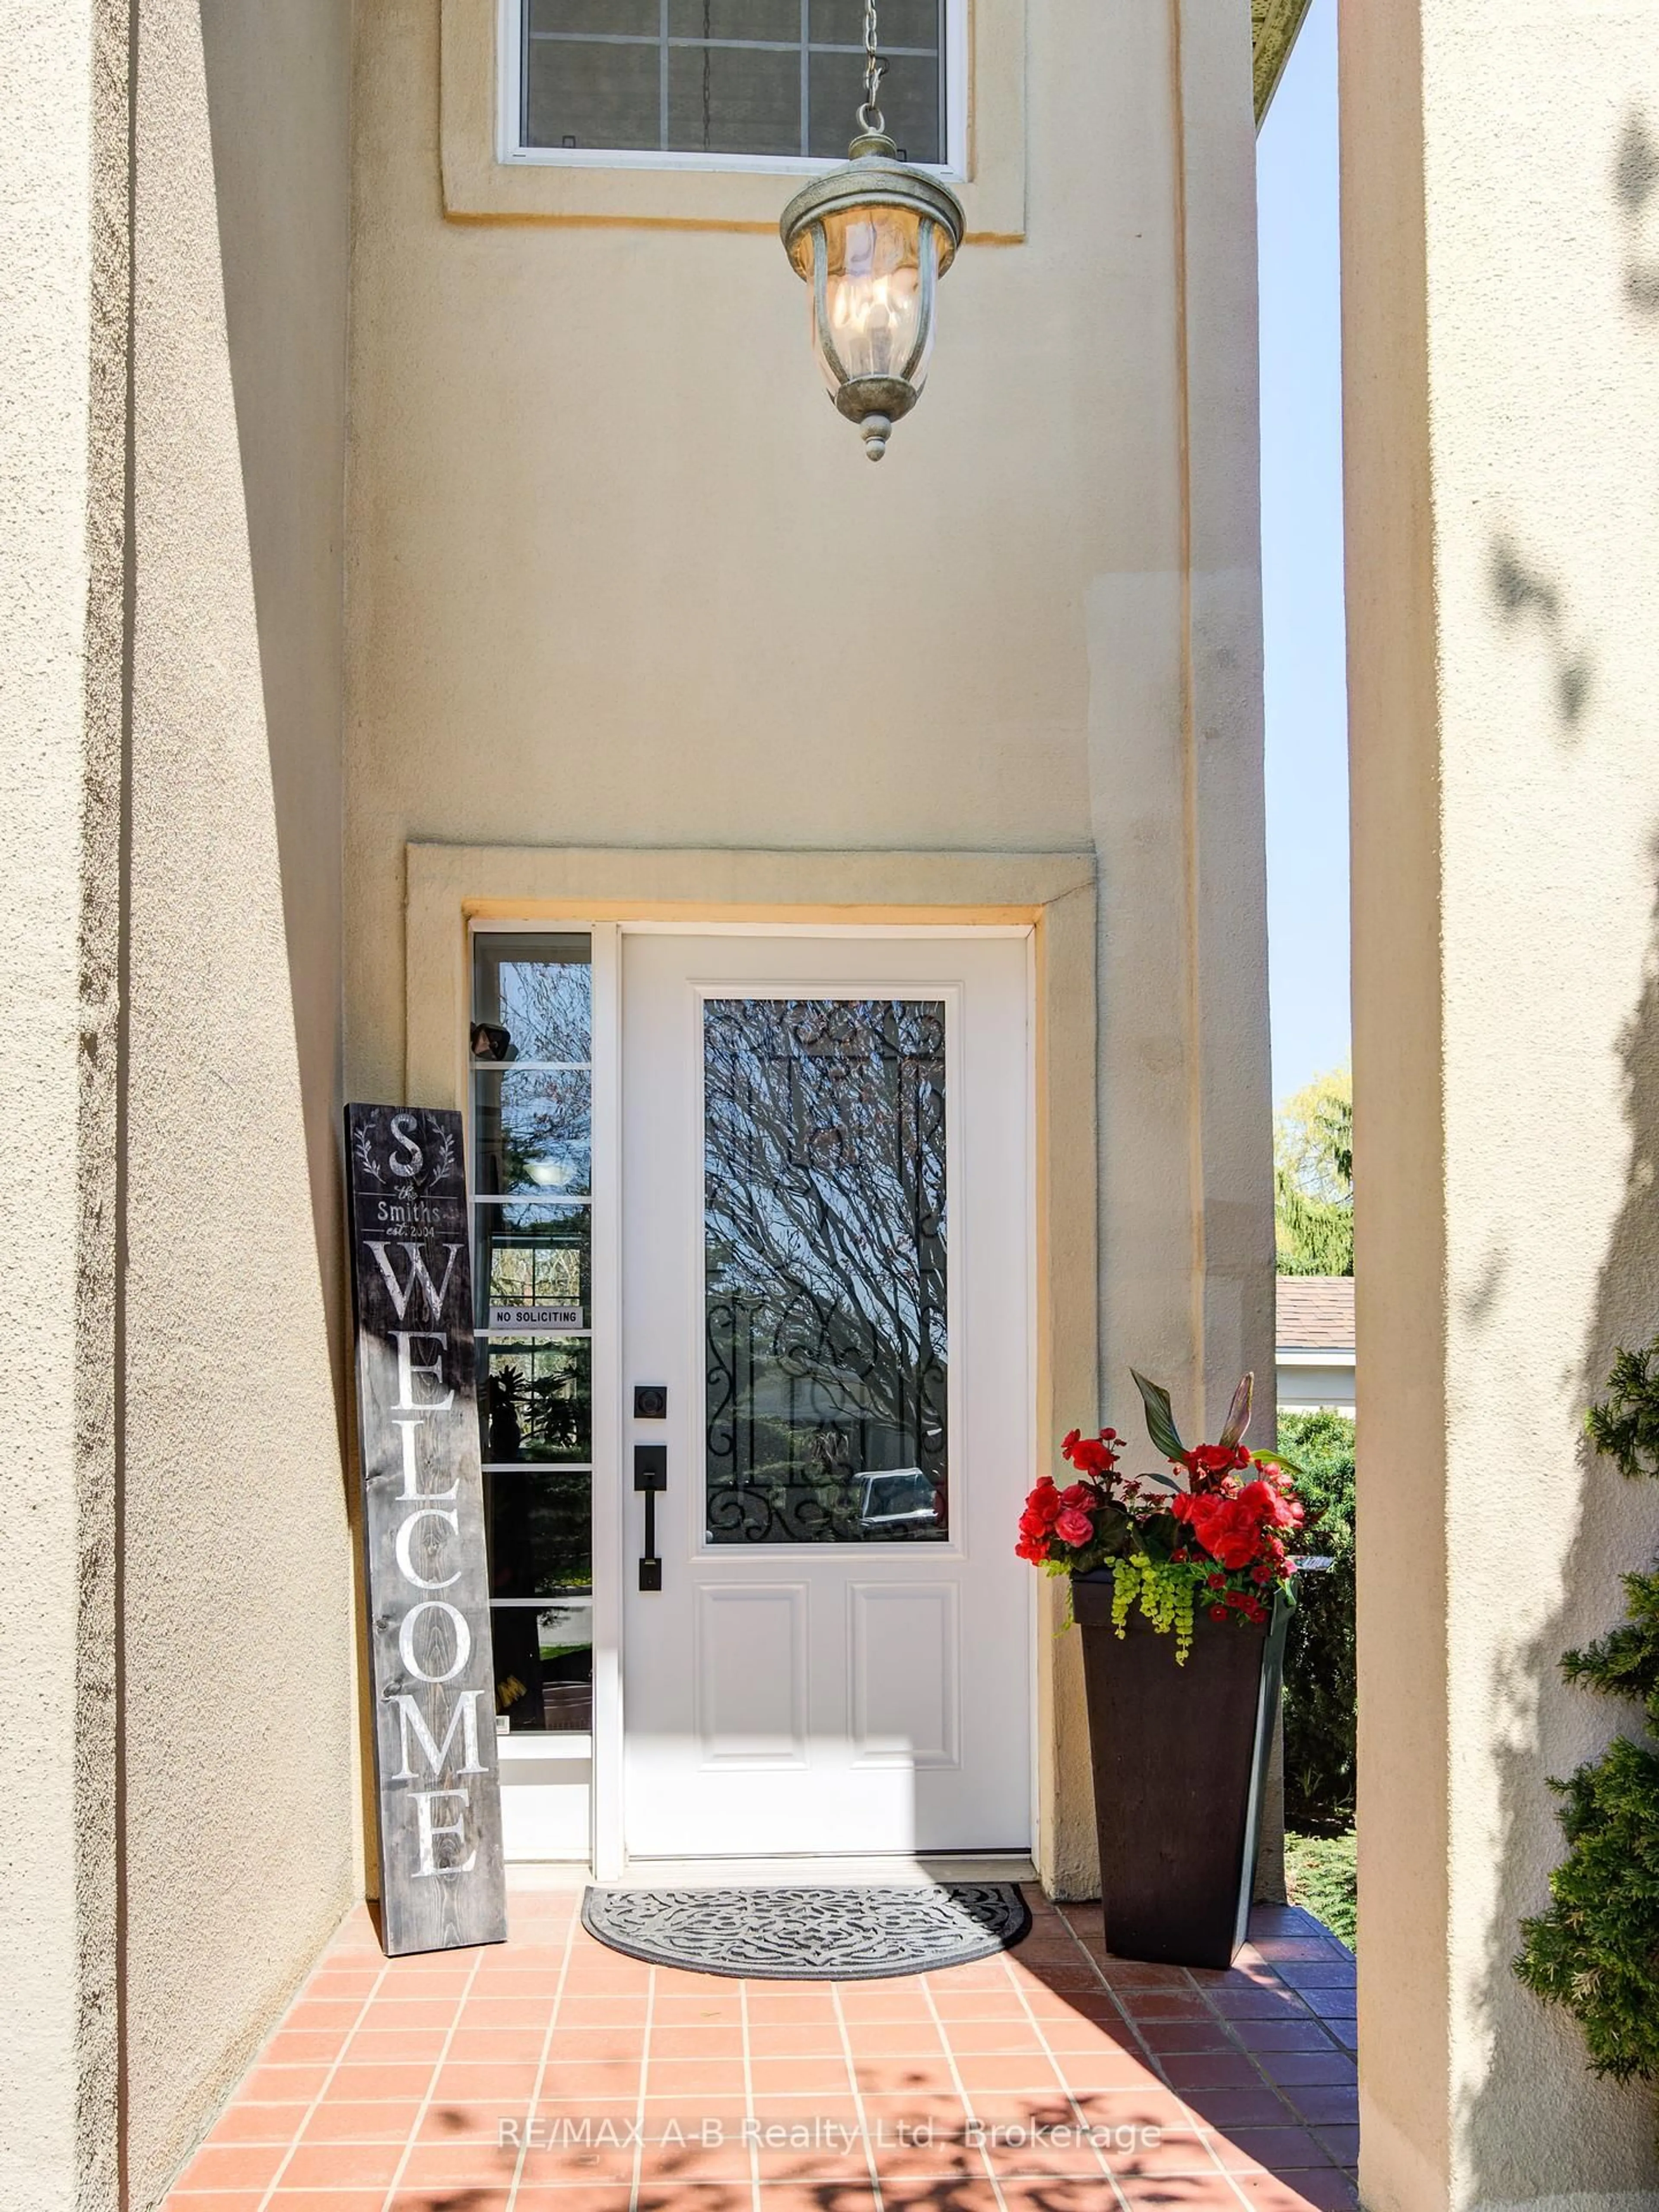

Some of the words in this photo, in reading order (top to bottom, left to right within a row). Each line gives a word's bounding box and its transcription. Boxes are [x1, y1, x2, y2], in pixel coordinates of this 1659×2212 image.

[389, 1113, 423, 1177] S
[394, 1183, 418, 1200] the
[377, 1201, 441, 1222] Smiths
[385, 1222, 408, 1236] est.
[410, 1227, 434, 1237] 2004
[497, 1312, 511, 1321] NO
[516, 1312, 577, 1322] SOLICITING
[363, 1241, 489, 1879] WELCOME
